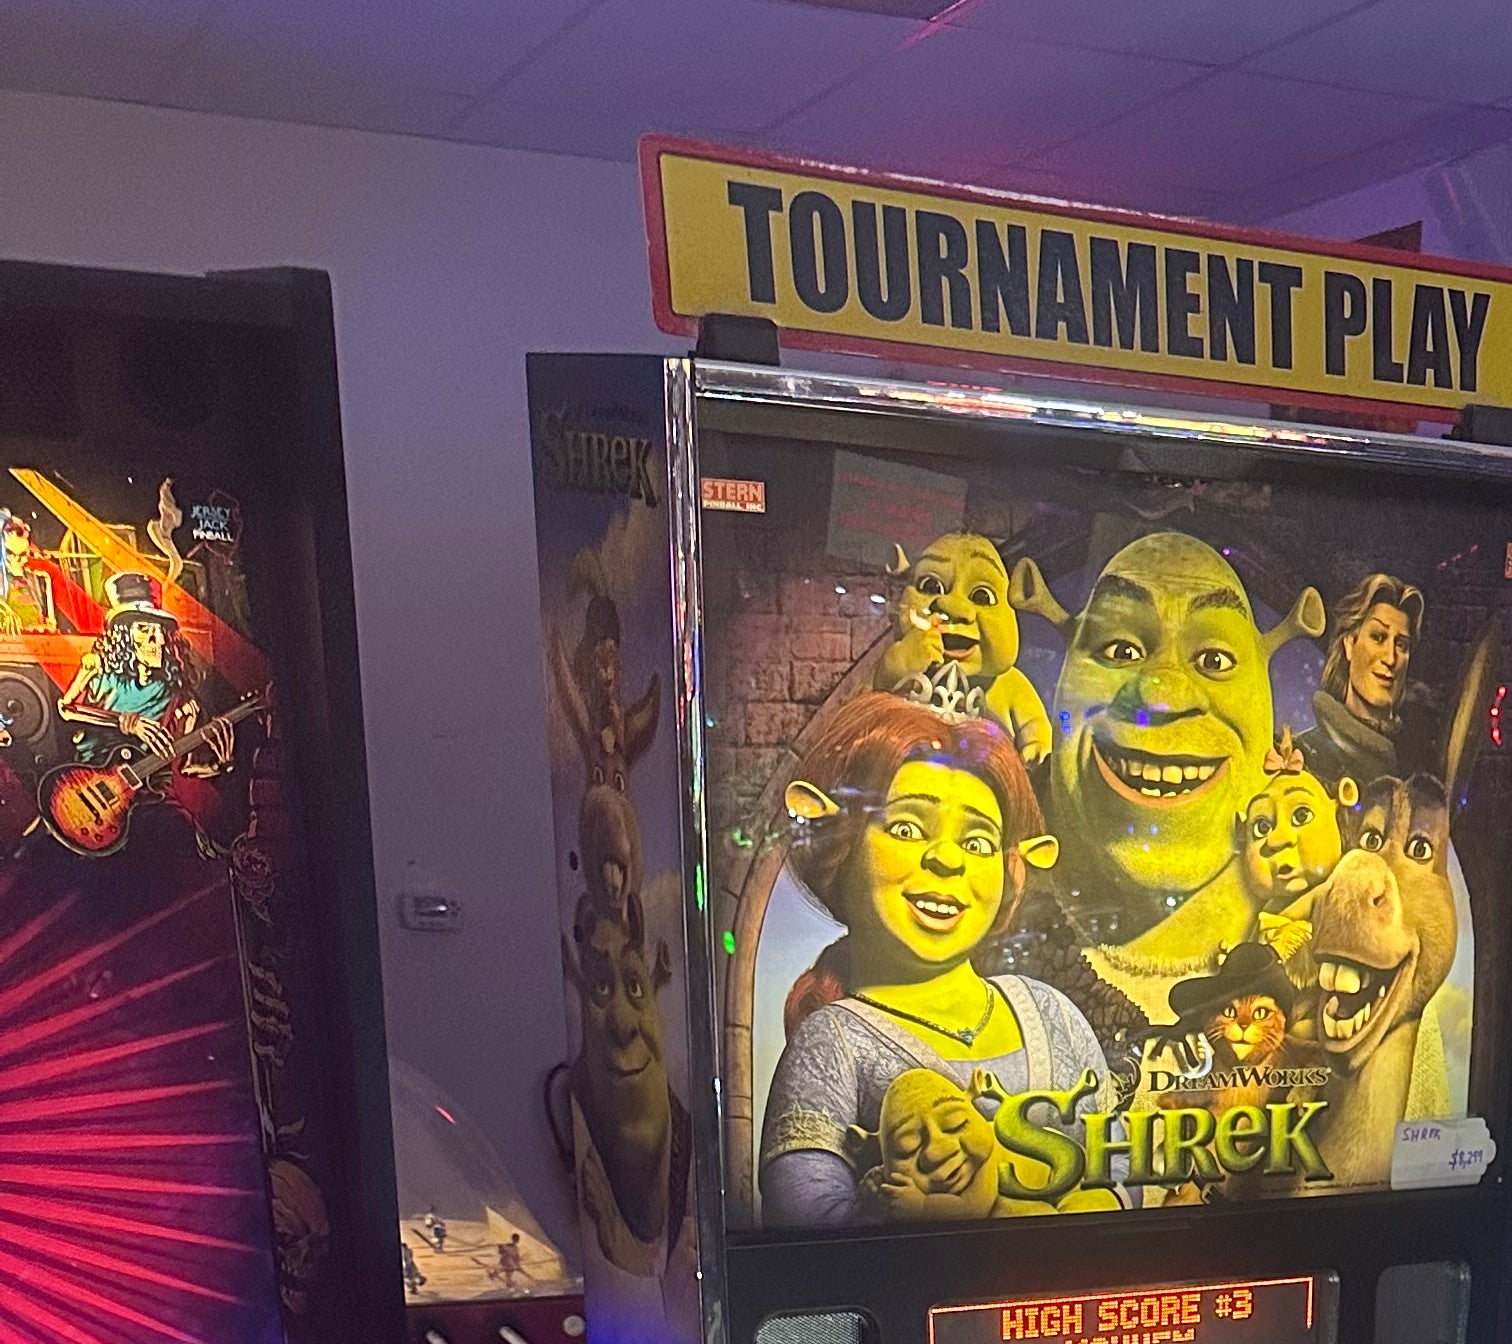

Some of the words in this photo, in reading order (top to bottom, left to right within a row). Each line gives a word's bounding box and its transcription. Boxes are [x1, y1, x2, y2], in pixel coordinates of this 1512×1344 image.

[727, 179, 1303, 370] TOURNAMENT
[1323, 269, 1491, 393] PLAY
[703, 481, 762, 502] STERN
[191, 505, 230, 519] JERSEY
[199, 519, 229, 531] JACK
[192, 529, 234, 542] PINBALL
[1002, 1303, 1083, 1341] HIGH
[1098, 1293, 1201, 1332] SCORE
[1214, 1289, 1253, 1320] #3
